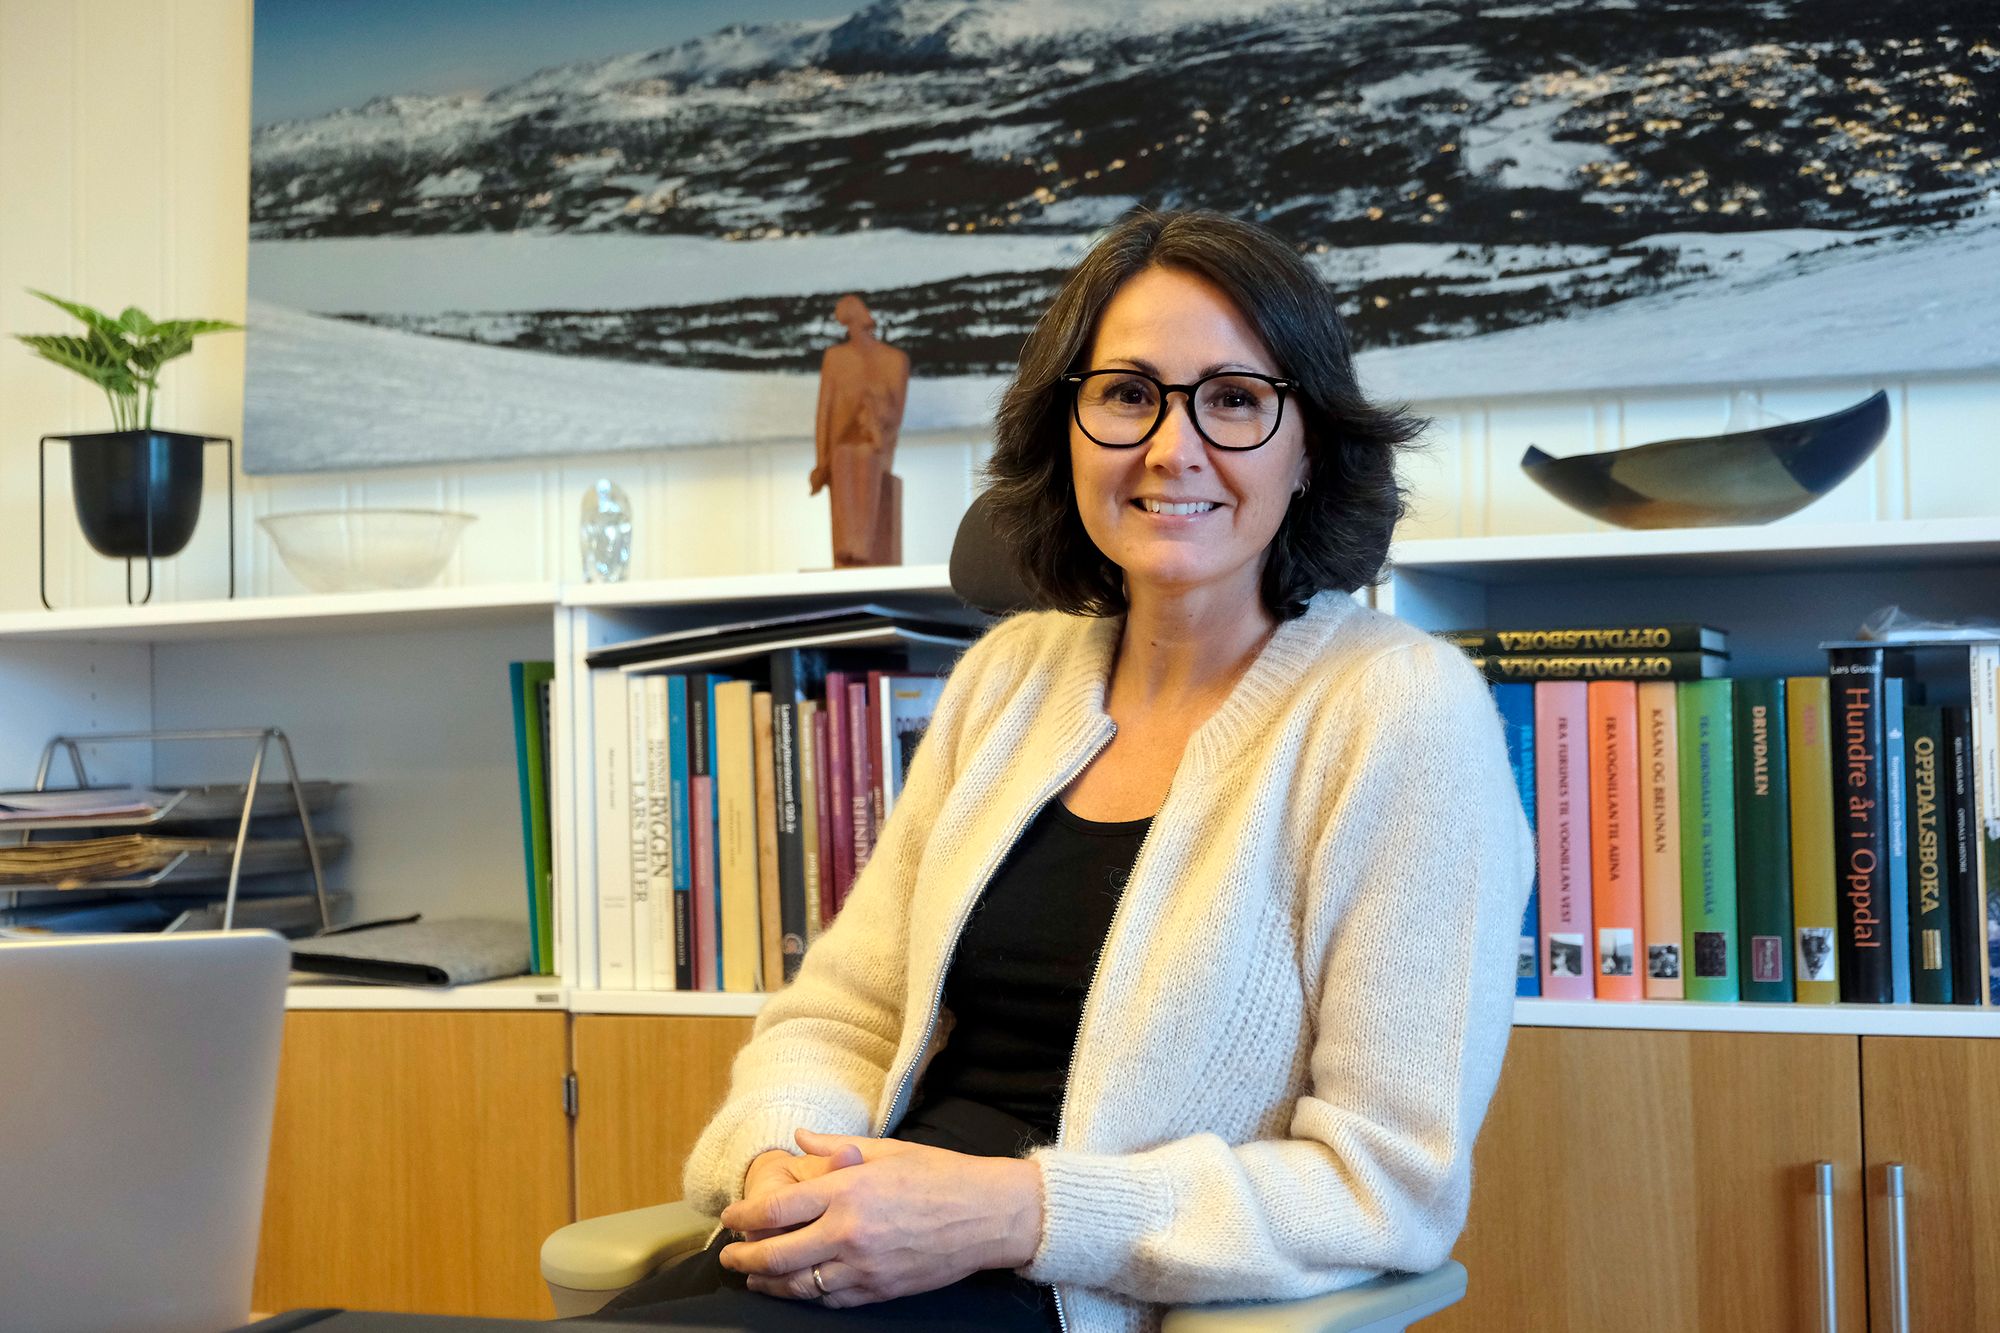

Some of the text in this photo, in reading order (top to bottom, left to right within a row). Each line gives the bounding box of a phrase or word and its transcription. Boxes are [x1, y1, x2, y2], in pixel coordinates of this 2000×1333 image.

[1497, 628, 1671, 650] OPPDALSBOKA
[1498, 656, 1672, 677] OPPDALSBOKA
[1830, 665, 1849, 674] Lars
[1700, 715, 1709, 738] FRA
[1752, 705, 1768, 796] DRIVDALEN
[1845, 688, 1874, 787] Hundre
[632, 781, 646, 830] LARS
[1606, 717, 1620, 882] FRA VOGNILLAN TIL AUNA
[1653, 762, 1665, 783] OG
[649, 796, 669, 878] RYGGEN
[1558, 717, 1571, 922] FRA FURUNES TIL VOGNILLAN VEST
[1653, 787, 1666, 854] BRENNAN
[1848, 795, 1875, 822] år
[1914, 736, 1940, 916] OPPDALSBOKA
[633, 836, 648, 902] TILLER
[1846, 848, 1881, 948] Oppdal
